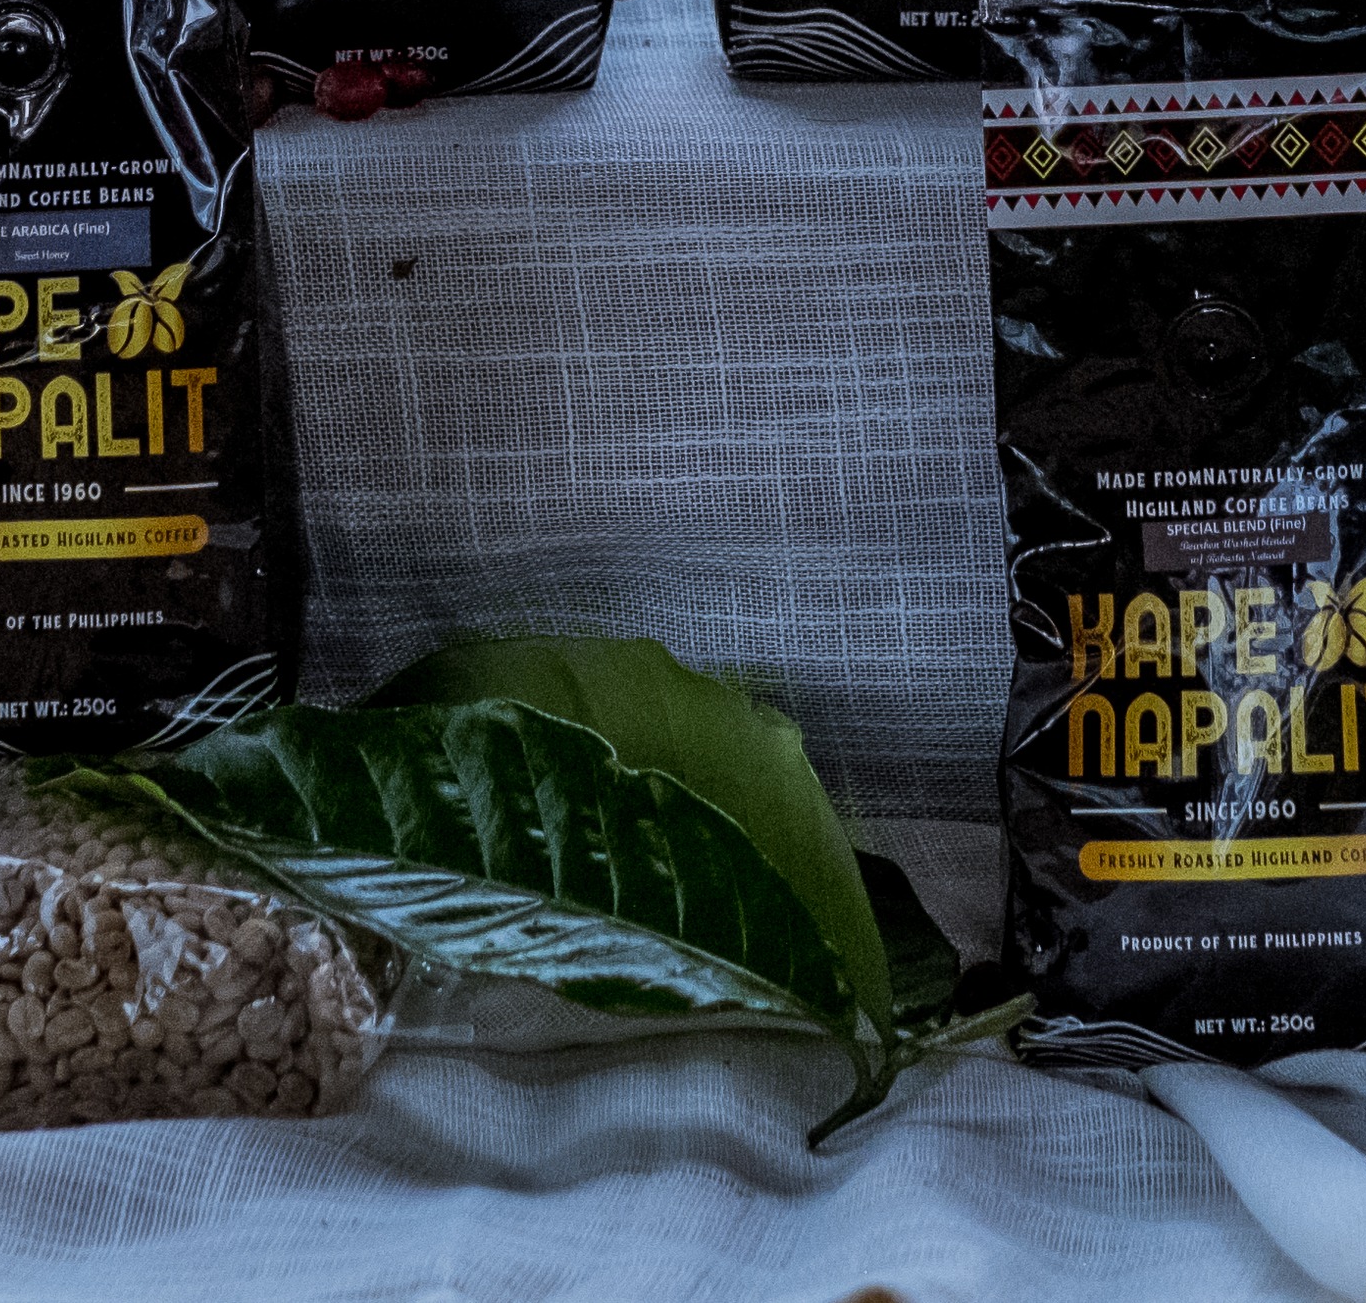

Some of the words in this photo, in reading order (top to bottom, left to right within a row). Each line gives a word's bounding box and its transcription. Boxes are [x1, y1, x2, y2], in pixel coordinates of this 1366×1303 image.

[900, 12, 928, 27] NET
[29, 189, 91, 206] COFFEE
[99, 186, 154, 203] BEANS
[11, 224, 69, 237] ARABICA
[73, 222, 110, 237] (Fine)
[1097, 472, 1145, 490] MADE
[54, 482, 102, 502] 1960
[1126, 499, 1216, 518] HIGHLAND
[1225, 496, 1287, 514] COFFEE
[1295, 493, 1349, 511] BEANS
[1166, 522, 1220, 536] SPECIAL
[1223, 520, 1266, 534] BLEND
[1269, 517, 1306, 532] (Fine)
[57, 531, 136, 546] HIGHLAND
[144, 527, 199, 544] COFFEE
[6, 616, 26, 629] OF
[33, 615, 61, 629] THE
[68, 610, 164, 629] PHILIPPINES
[1067, 586, 1277, 682] KAPE
[73, 698, 117, 716] 250G
[1185, 802, 1238, 822] SINCE
[1247, 800, 1296, 819] 1960
[1098, 853, 1165, 868] FRESHLY
[1252, 850, 1333, 866] HIGHLAND
[1121, 935, 1193, 951] PRODUCT
[1201, 936, 1220, 950] OF
[1228, 935, 1257, 949] THE
[1265, 931, 1362, 948] PHILIPPINES
[1194, 1019, 1225, 1035] NET
[1270, 1014, 1315, 1032] 250G
